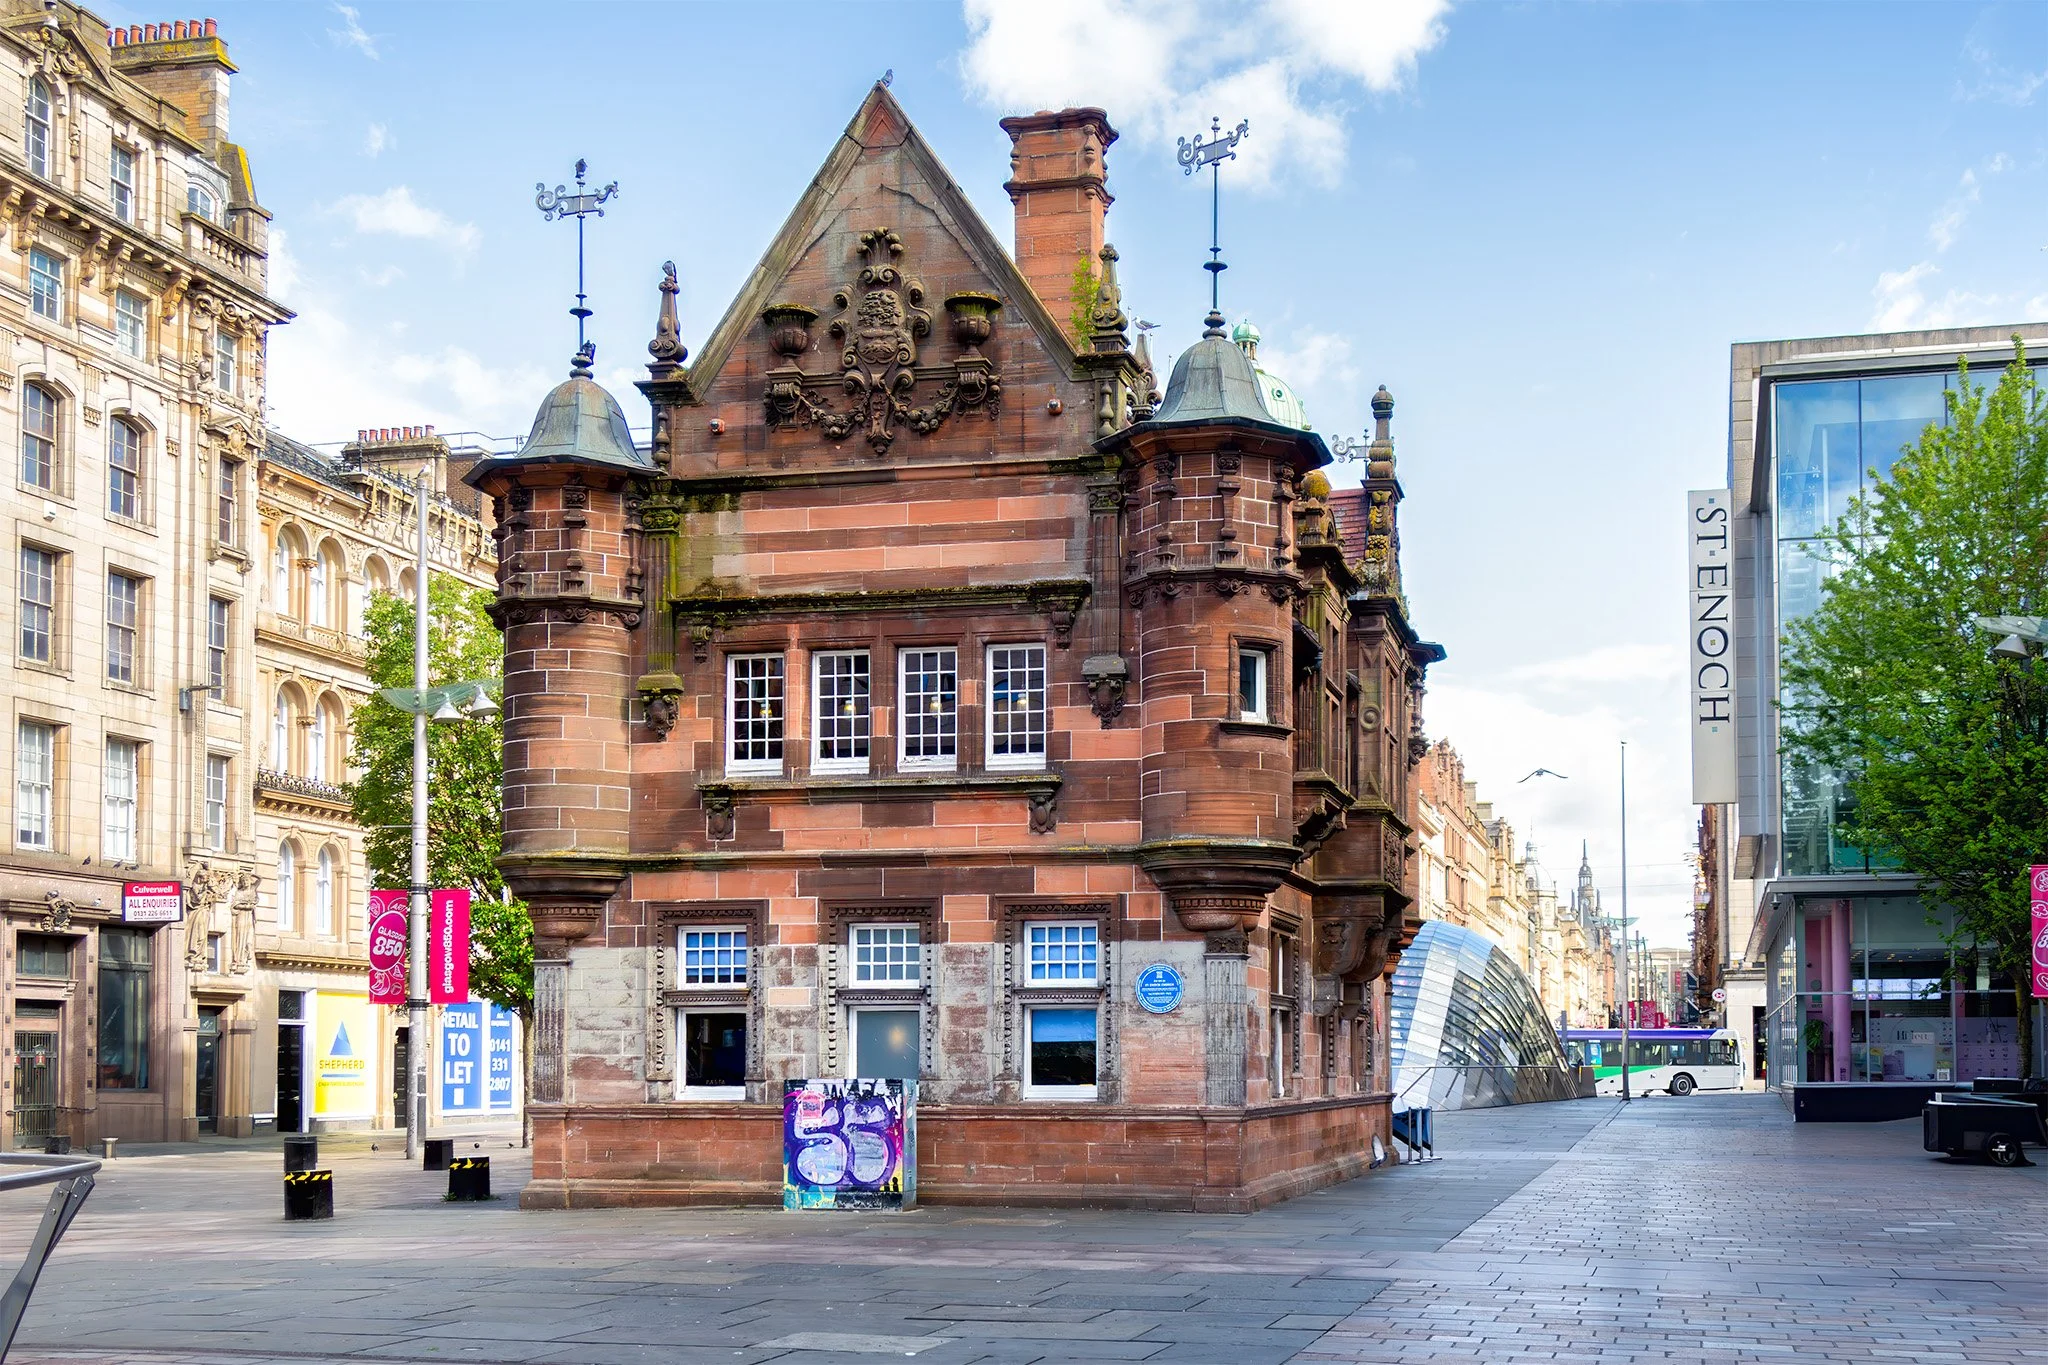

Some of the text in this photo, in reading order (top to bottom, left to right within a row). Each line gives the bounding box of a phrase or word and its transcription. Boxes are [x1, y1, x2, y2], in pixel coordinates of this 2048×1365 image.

[1696, 507, 1730, 725] ST ENOCH
[132, 885, 174, 894] Culverwell
[128, 898, 177, 910] ALL ENQUIRIES
[373, 936, 403, 957] 850
[442, 899, 454, 994] glasgow850.com
[443, 1011, 479, 1029] RETAIL
[447, 1032, 471, 1056] TO
[490, 1039, 511, 1052] 0141
[319, 1060, 365, 1070] SHEPHERD
[444, 1061, 474, 1085] LET
[492, 1057, 509, 1072] 331
